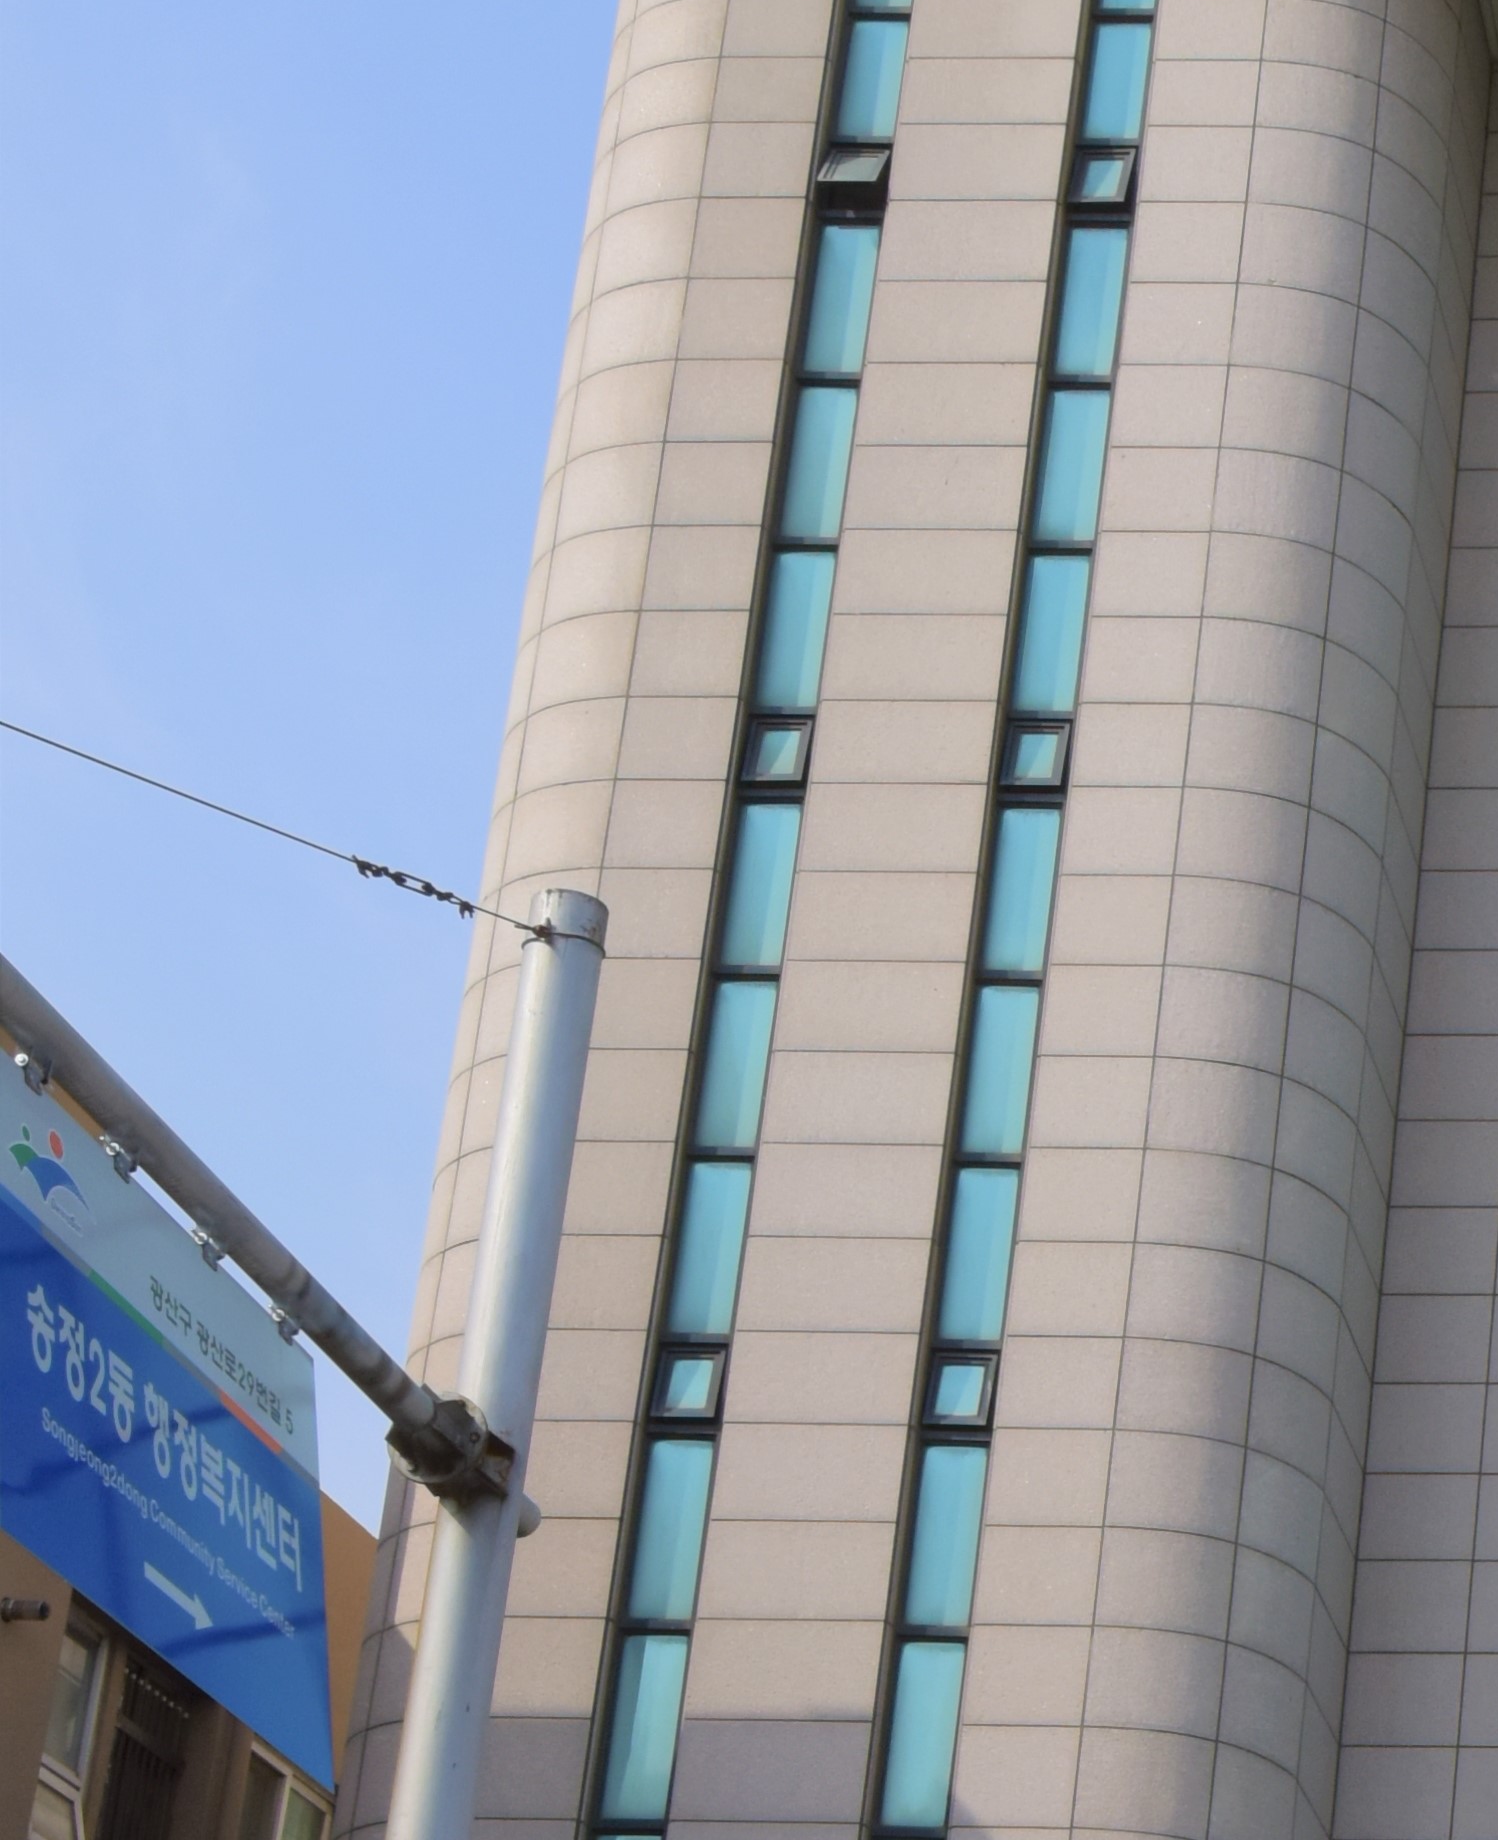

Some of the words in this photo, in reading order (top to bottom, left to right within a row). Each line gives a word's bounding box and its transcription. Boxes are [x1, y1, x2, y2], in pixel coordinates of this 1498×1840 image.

[26, 1284, 136, 1444] 송정2동
[143, 1382, 302, 1593] 행정복지센터
[151, 1275, 192, 1336] 광산구
[197, 1320, 282, 1426] 광산로29번길
[284, 1408, 293, 1435] 5
[42, 1407, 148, 1520] Songjeong2dong
[149, 1498, 216, 1577] Community
[216, 1556, 260, 1614] Service
[259, 1594, 294, 1639] Center
